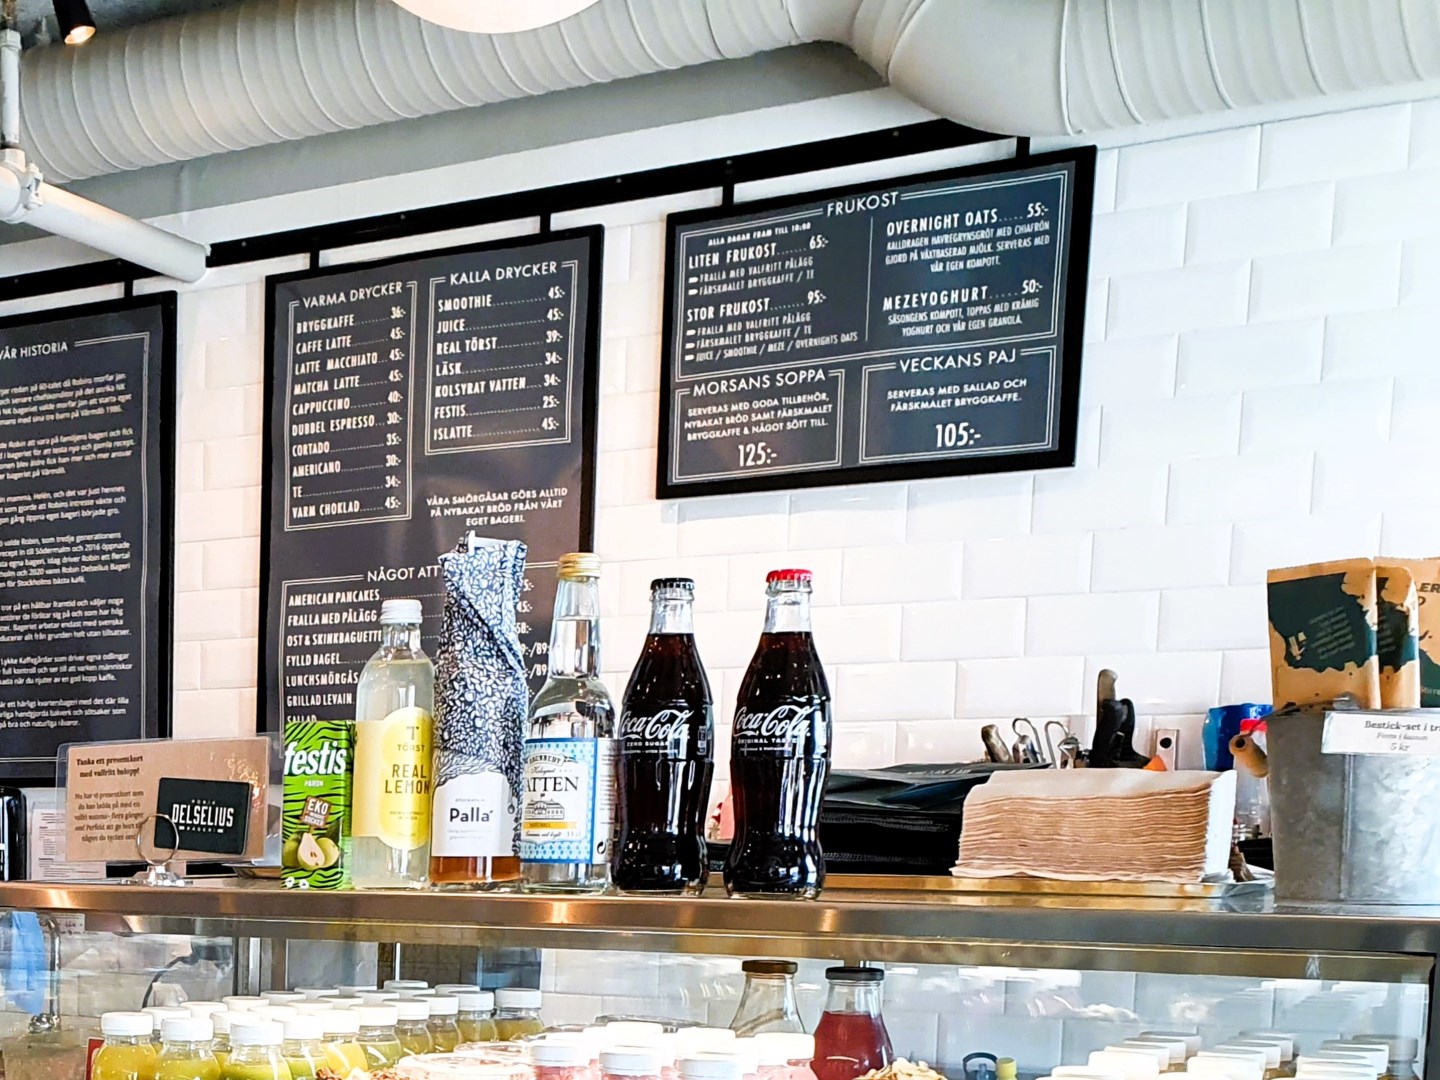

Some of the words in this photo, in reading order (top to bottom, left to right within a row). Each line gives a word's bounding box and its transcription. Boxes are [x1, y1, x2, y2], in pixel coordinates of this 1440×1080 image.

[827, 191, 898, 216] FRUKOST
[887, 214, 959, 236] OVERNIGHT
[966, 209, 997, 226] OATS
[1027, 202, 1048, 218] 55:-
[689, 252, 719, 269] LITEN
[726, 243, 776, 263] FRUKOST
[810, 235, 828, 249] 65:-
[451, 270, 490, 285] KALLA
[496, 262, 556, 280] DRYCKER
[303, 292, 346, 308] VARMA
[350, 282, 402, 301] DRYCKER
[438, 294, 492, 312] SMOOTHIE
[548, 286, 565, 298] 45:-
[688, 306, 714, 322] STOR
[720, 298, 770, 317] FRUKOST
[808, 290, 826, 304] 95:-
[883, 286, 987, 310] MEZEYOGHURT
[1022, 280, 1042, 294] 50:-
[297, 314, 354, 334] BRYGGKAFFE
[391, 306, 406, 318] 36:-
[437, 319, 464, 333] JUICE
[547, 308, 564, 320] 45:-
[20, 342, 67, 357] HISTORIA
[296, 340, 322, 354] CAFFE
[326, 336, 351, 350] LATTE
[390, 327, 405, 339] 45:-
[437, 341, 461, 355] REAL
[465, 337, 497, 352] TÖRST
[546, 330, 562, 342] 39:-
[295, 360, 320, 375] LATTE
[327, 352, 377, 370] MACCHIATO
[390, 348, 404, 360] 45:-
[436, 361, 461, 376] LÄSK
[545, 352, 562, 364] 34:-
[900, 353, 981, 372] VECKANS
[989, 348, 1015, 364] PAJ
[294, 380, 328, 395] MATCHA
[334, 376, 360, 390] LATTE
[389, 370, 403, 381] 45:-
[435, 382, 485, 398] KOLSYRAT
[490, 377, 526, 392] VATTEN
[544, 374, 560, 386] 34:-
[694, 375, 770, 396] MORSANS
[776, 369, 825, 386] SOPPA
[888, 387, 934, 399] SERVERAS
[938, 386, 960, 394] MED
[964, 382, 1000, 392] SALLAD
[1004, 379, 1026, 388] OCH
[293, 398, 350, 415] CAPPUCCINO
[388, 391, 403, 402] 40:-
[434, 404, 465, 419] FESTIS
[543, 396, 560, 408] 25:-
[292, 422, 325, 436] DUBBEL
[330, 415, 374, 431] ESPRESSO
[387, 412, 402, 424] 30:-
[434, 425, 472, 440] ISLATTE
[542, 417, 559, 430] 45:-
[936, 422, 980, 447] 105:-
[292, 442, 329, 456] CORTADO
[386, 433, 401, 445] 35:-
[738, 442, 777, 466] 125:-
[293, 461, 340, 477] AMERICANO
[386, 454, 401, 466] 30:-
[293, 486, 302, 498] TE
[386, 476, 401, 487] 34:-
[427, 496, 450, 505] VÅRA
[452, 492, 508, 504] SMÖRGÅSAR
[511, 490, 536, 500] GÖRS
[539, 488, 568, 497] ALLTID
[292, 506, 315, 518] VARM
[320, 500, 359, 516] CHOKLAD
[385, 497, 401, 508] 45:-
[431, 507, 441, 517] PÅ
[444, 506, 484, 516] NYBAKAT
[487, 503, 512, 513] BRÖD
[514, 500, 538, 511] FRÅN
[541, 498, 562, 508] VÅRT
[466, 517, 488, 526] EGET
[367, 565, 414, 582] NÅGOT
[417, 566, 440, 579] ATT
[289, 593, 334, 606] AMERICAN
[336, 589, 379, 603] PANCAKES
[288, 614, 319, 626] FRALLA
[322, 613, 340, 624] MED
[342, 608, 377, 623] PÅLÄGG
[287, 635, 303, 646] OST
[304, 635, 310, 645] &
[313, 630, 382, 645] SKINKBAGUETTE
[286, 654, 311, 666] FYLLD
[314, 653, 341, 665] BAGEL
[286, 670, 358, 686] LUNCHSMÖRGÅS
[287, 695, 321, 706] GRILLAD
[323, 693, 352, 705] LEVAIN
[620, 709, 694, 740] Coca-Cola
[734, 705, 815, 736] Coca-Cola
[1365, 720, 1420, 729] Bestick-set
[284, 740, 346, 775] festis
[397, 744, 425, 753] TÖRST
[80, 770, 92, 778] med
[392, 764, 427, 779] REAL
[385, 780, 430, 794] LEMON
[172, 803, 234, 827] DELSELIUS
[308, 798, 328, 814] EKO
